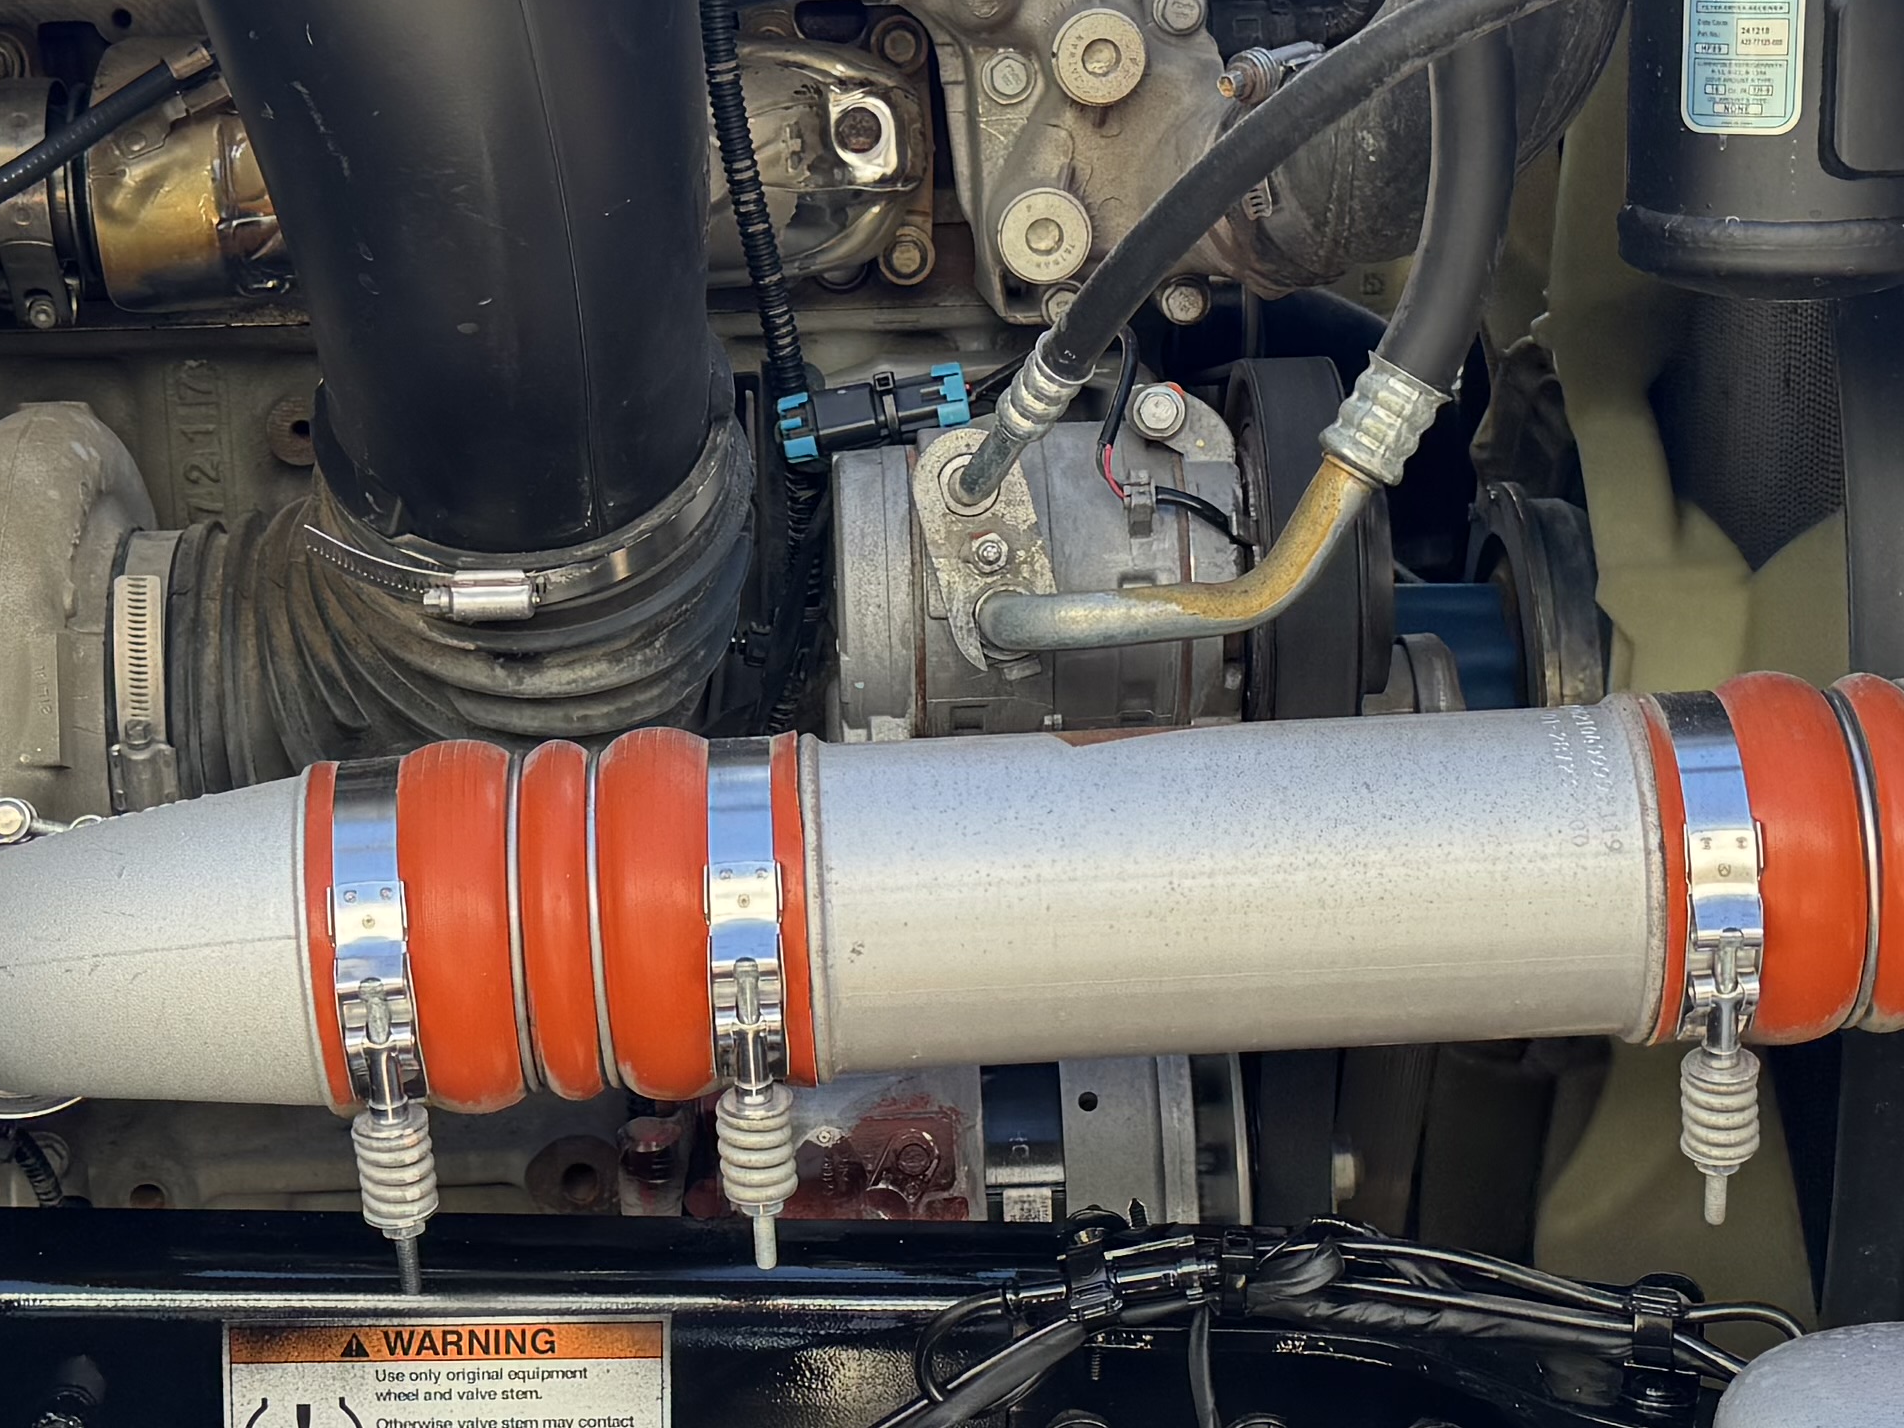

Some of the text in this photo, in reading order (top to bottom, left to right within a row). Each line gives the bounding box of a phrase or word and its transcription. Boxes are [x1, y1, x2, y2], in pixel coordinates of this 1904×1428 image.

[383, 1328, 557, 1357] WARNING
[375, 1367, 587, 1386] Use only original equipment
[375, 1387, 542, 1402] wheel and valve stem.
[500, 1417, 539, 1428] stem
[578, 1416, 634, 1428] contact
